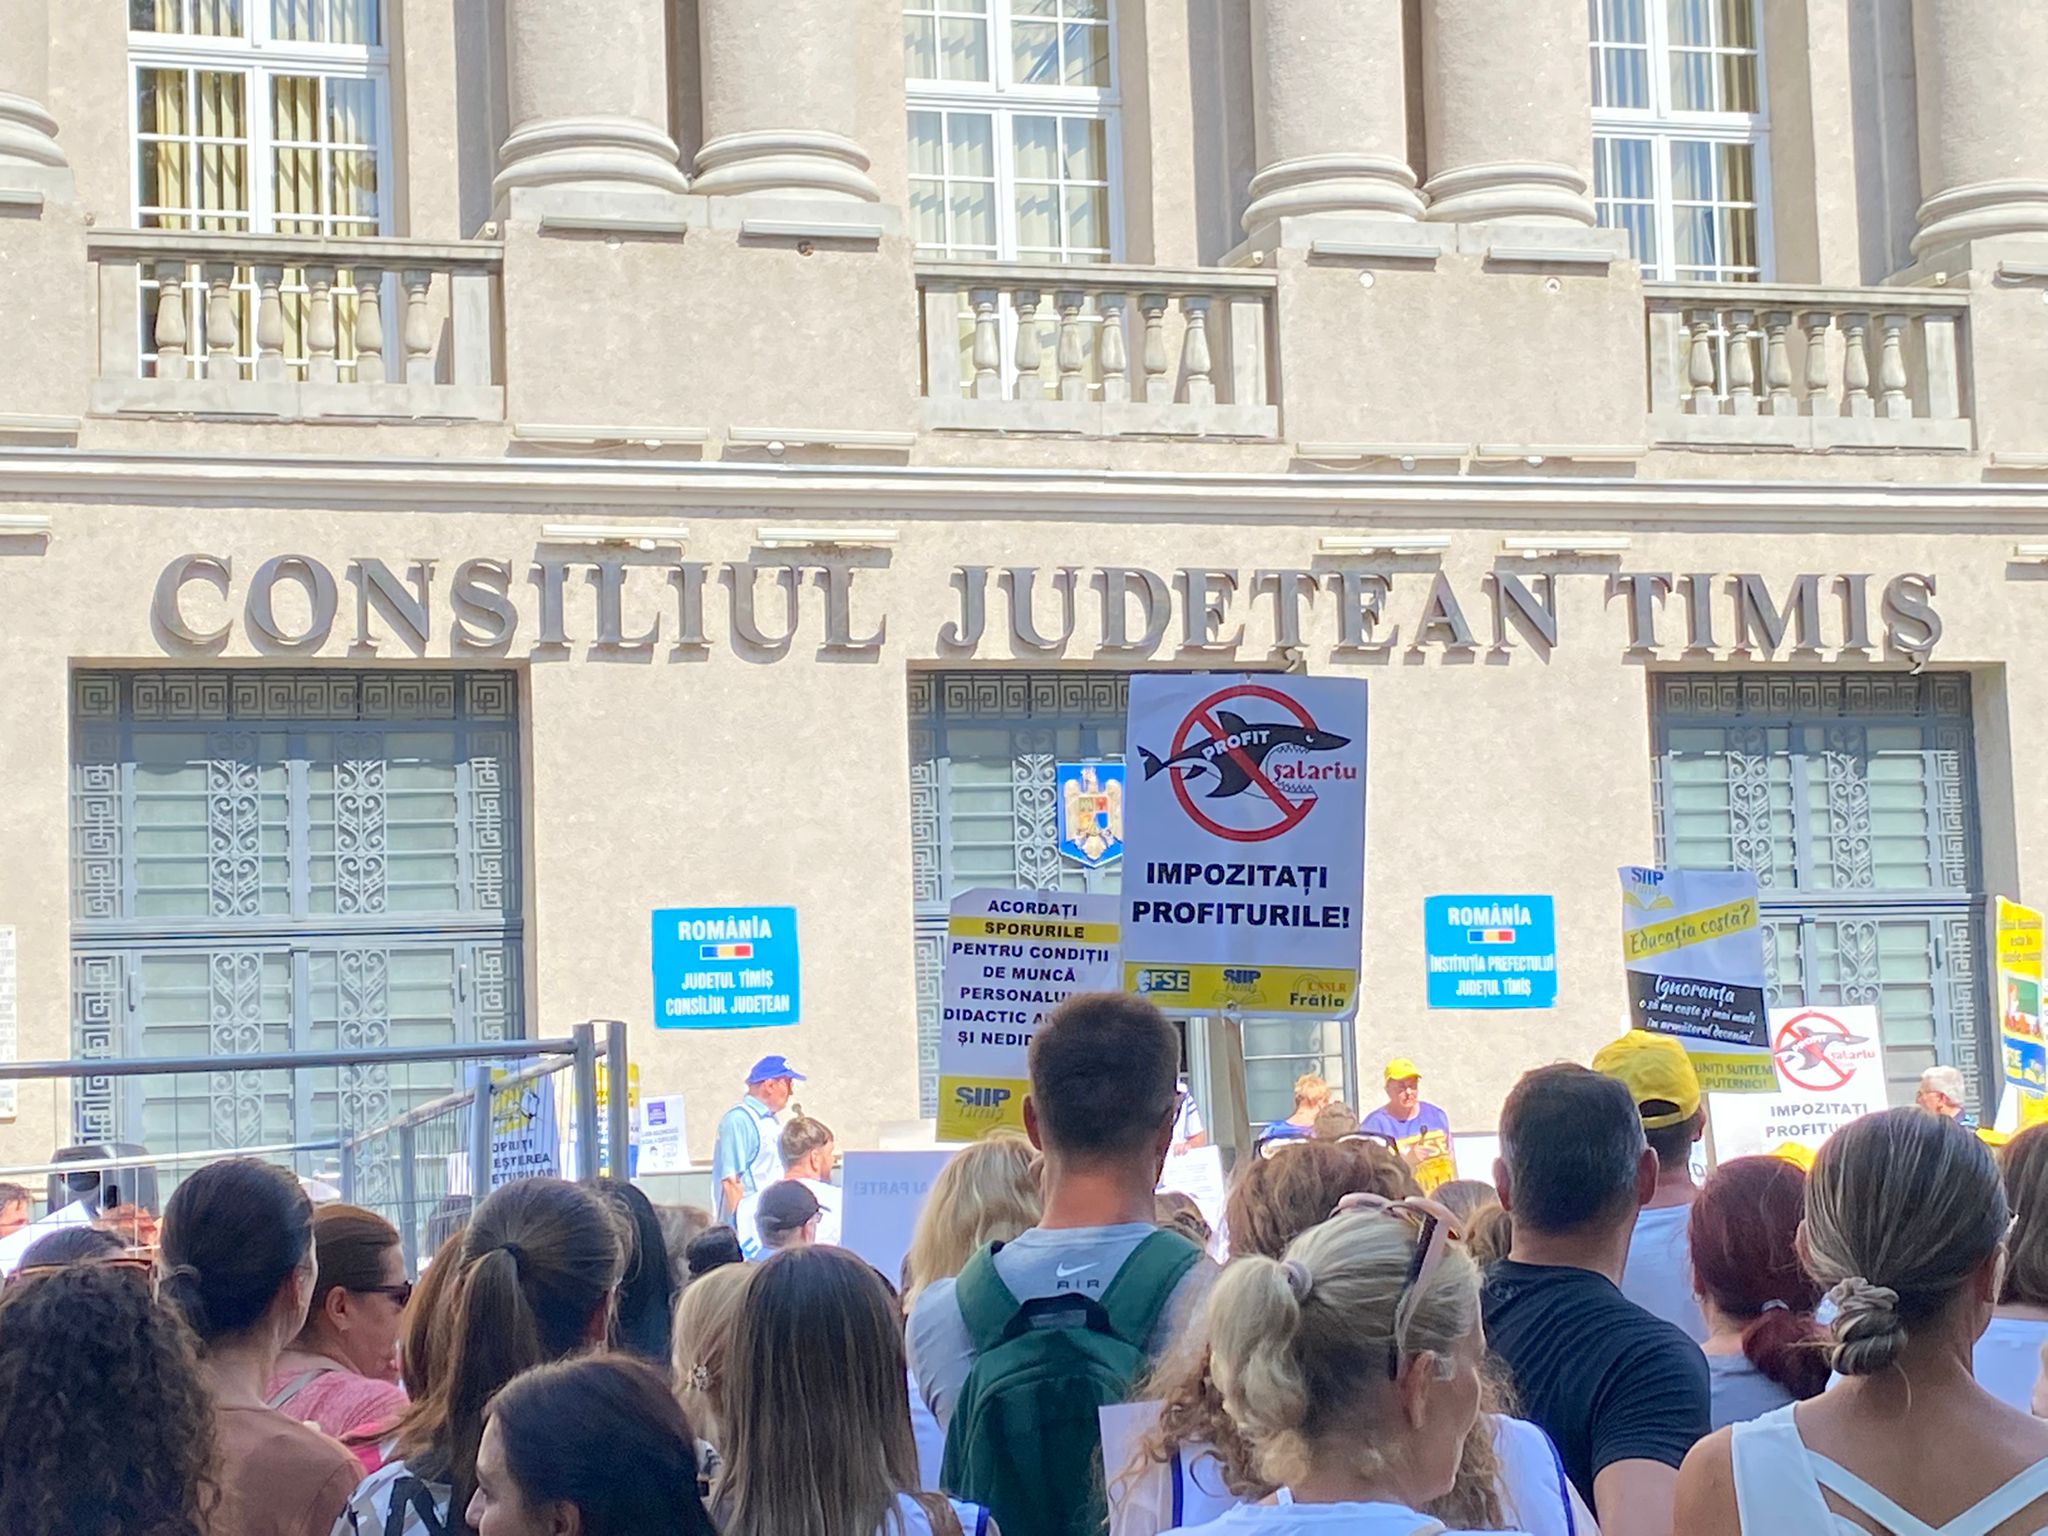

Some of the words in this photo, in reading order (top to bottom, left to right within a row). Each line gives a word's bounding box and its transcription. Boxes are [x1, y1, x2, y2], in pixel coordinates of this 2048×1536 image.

[168, 553, 888, 649] CONSILIUL
[1201, 730, 1270, 760] PROFIT
[1147, 862, 1327, 896] IMPOZITAȚI
[1631, 867, 1664, 886] SIIP
[988, 900, 1078, 919] ACORDAȚI
[1132, 901, 1350, 928] PROFITURILE!
[985, 921, 1085, 938] SPORURILE
[952, 942, 1023, 957] PENTRU
[1030, 946, 1109, 965] CONDIȚII
[983, 966, 1006, 978] DE
[1012, 967, 1076, 982] MUNCĂ
[1151, 972, 1188, 989] FSE
[960, 987, 1071, 1003] PERSONALU
[1655, 975, 1735, 1007] Ignoranța
[943, 1008, 1027, 1024] DIDACTIC
[958, 1031, 974, 1047] ȘI
[955, 1086, 1011, 1107] SIIP
[1765, 1123, 1840, 1138] PROFITU
[493, 1153, 551, 1170] EȘTEREA
[1057, 1279, 1100, 1289] AIR
